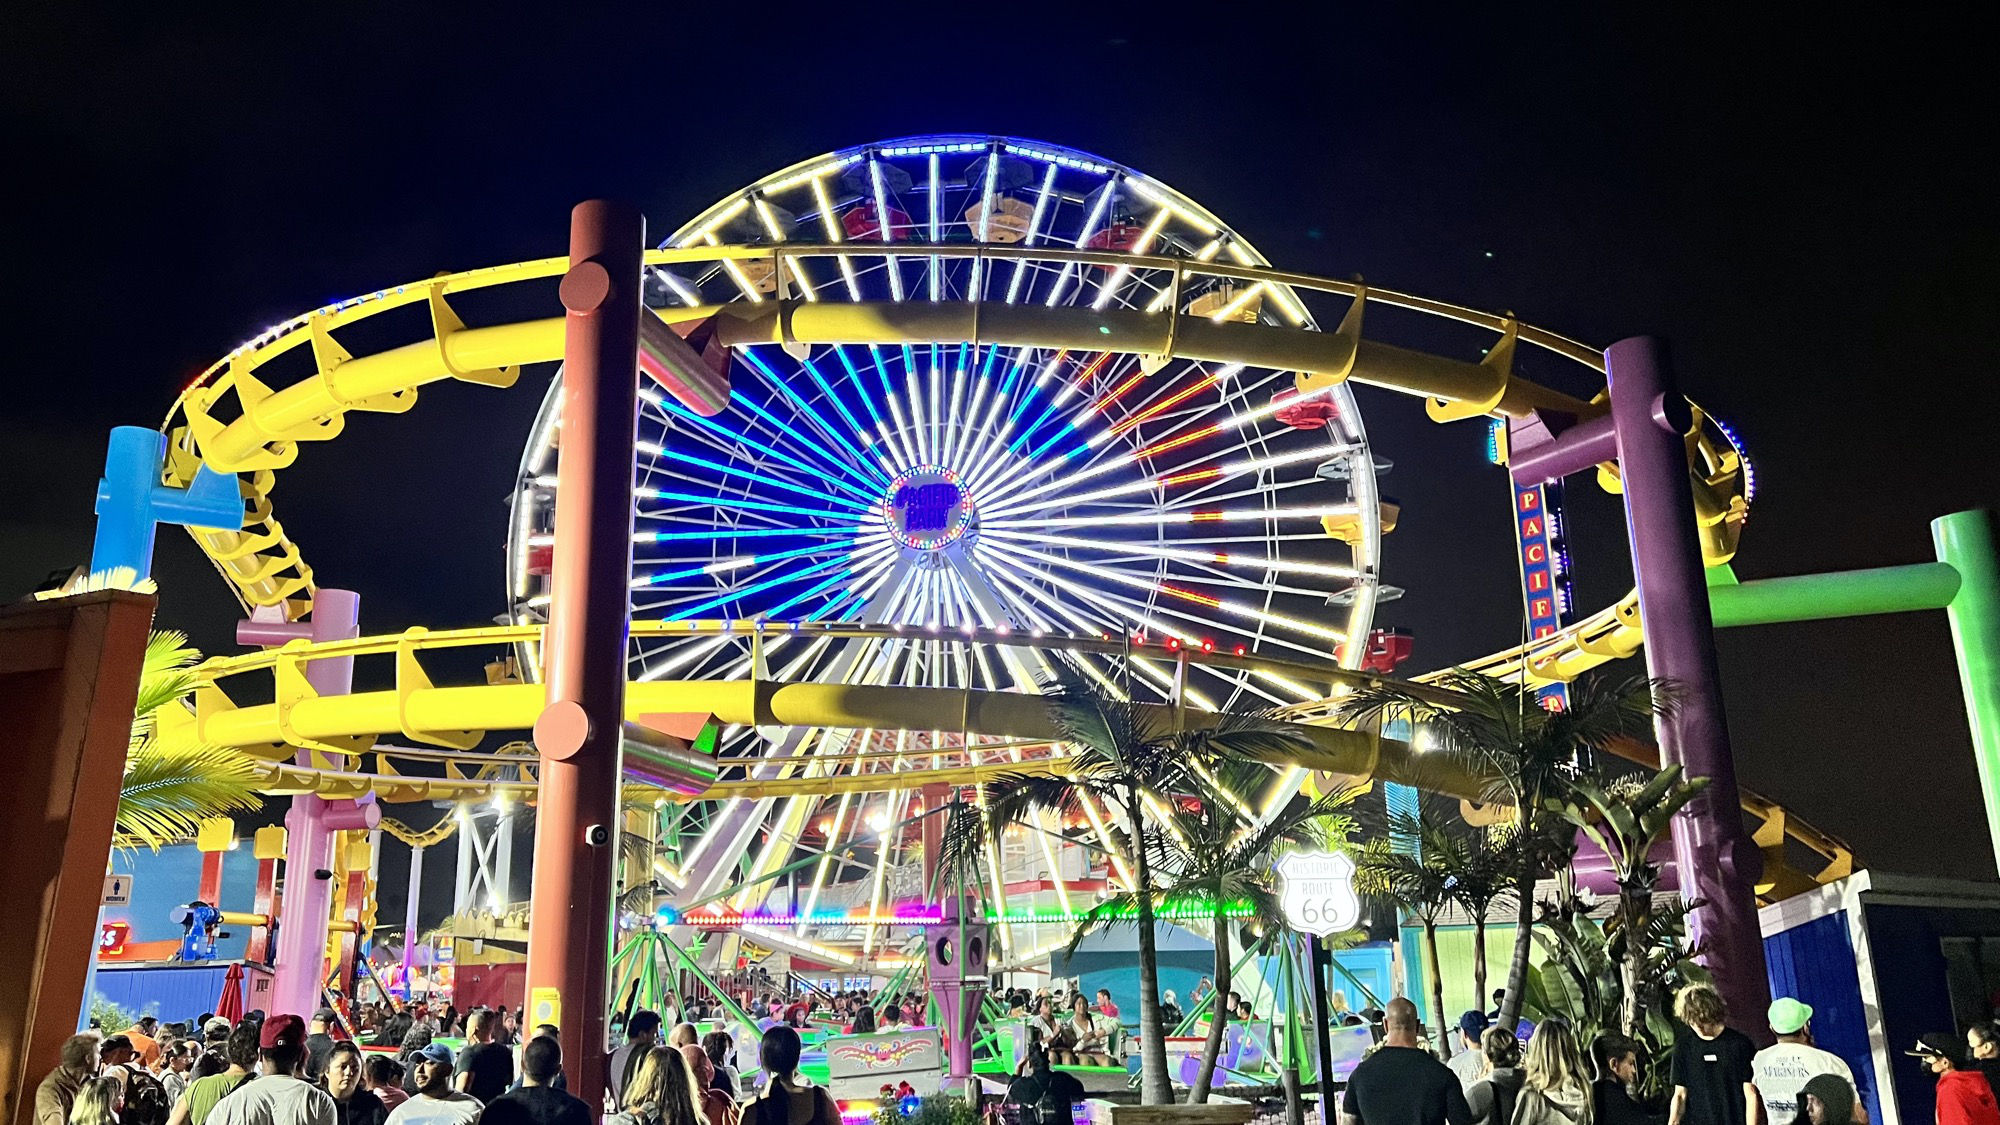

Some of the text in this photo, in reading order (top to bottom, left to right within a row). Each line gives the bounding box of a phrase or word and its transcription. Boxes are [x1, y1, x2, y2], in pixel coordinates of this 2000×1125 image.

[1522, 492, 1553, 656] PACIFI
[1292, 862, 1339, 875] HISTORIC
[1302, 882, 1334, 896] ROUTE
[1302, 898, 1338, 924] 66
